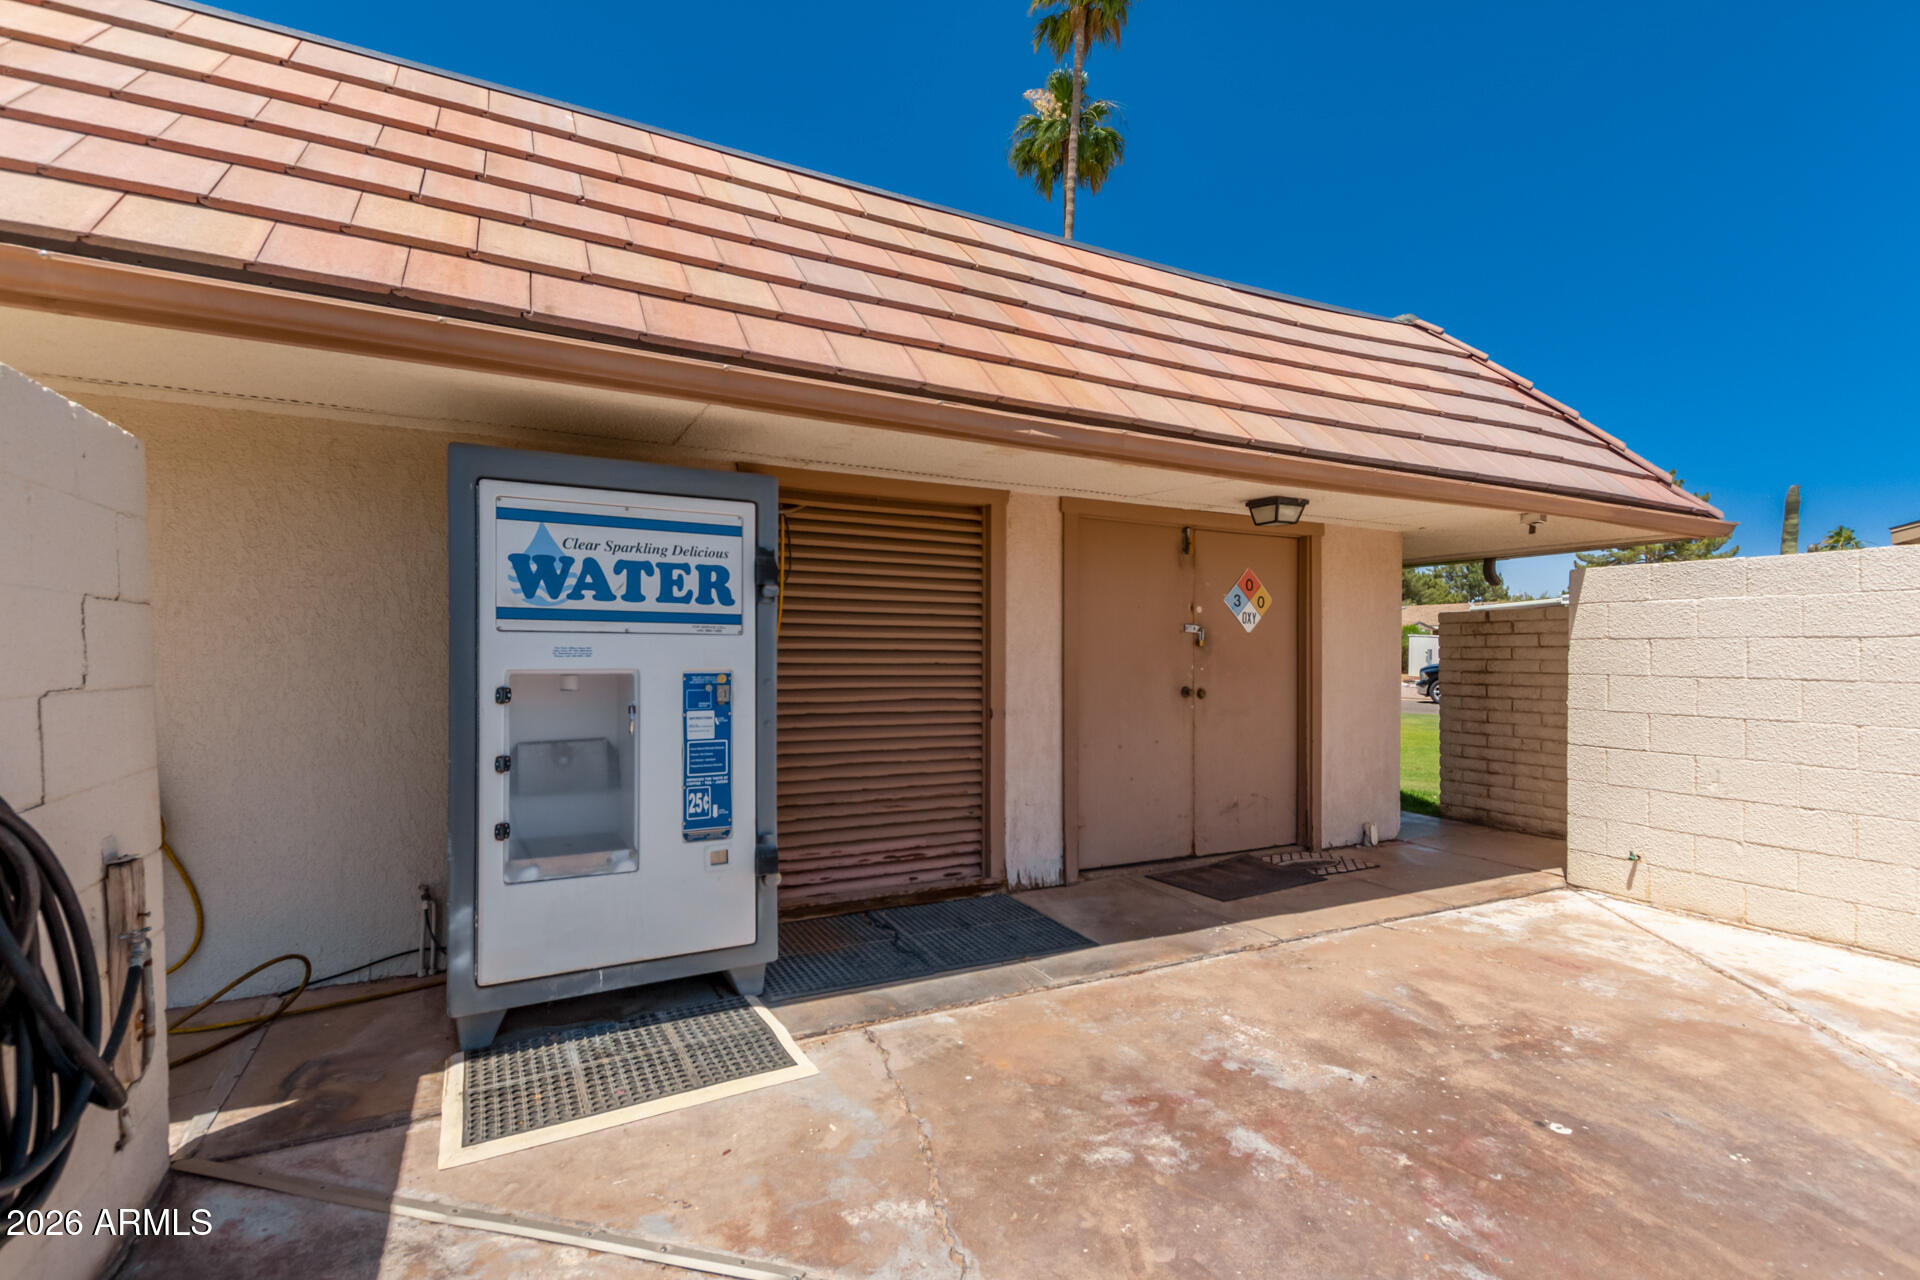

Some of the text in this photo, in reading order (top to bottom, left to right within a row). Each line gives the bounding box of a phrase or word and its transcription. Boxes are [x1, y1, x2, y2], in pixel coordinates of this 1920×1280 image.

[562, 537, 729, 560] Clear Sparkling Delicious
[508, 553, 735, 607] WATER
[1245, 578, 1254, 592] 0
[1233, 594, 1242, 607] 3
[1257, 596, 1265, 609] 0
[1241, 611, 1257, 625] OXY
[688, 792, 709, 813] 25¢
